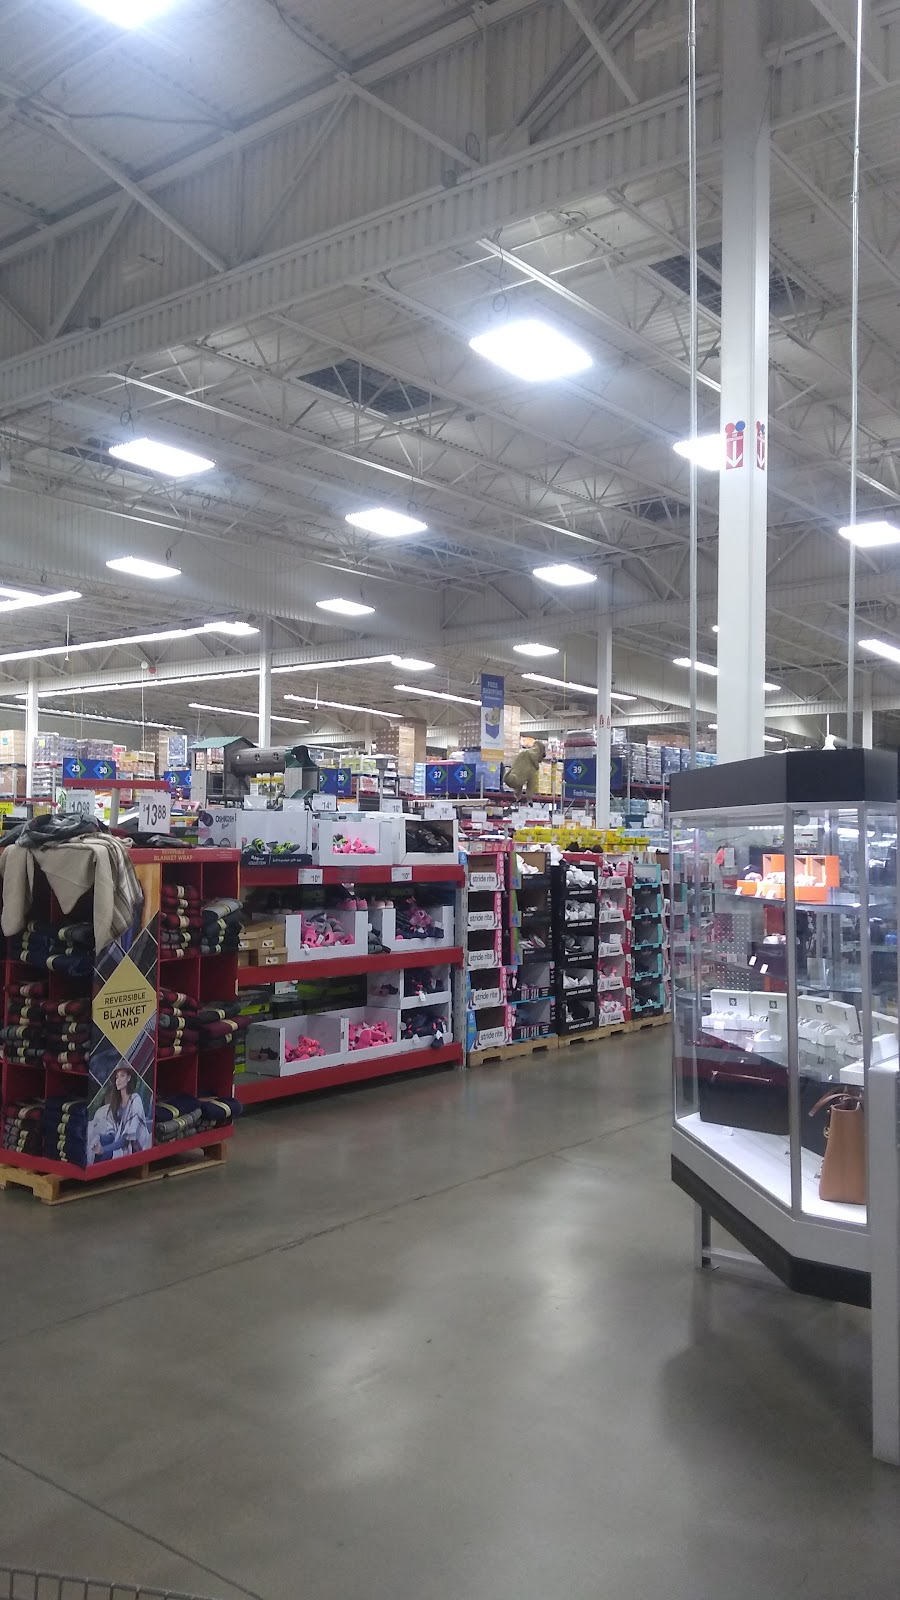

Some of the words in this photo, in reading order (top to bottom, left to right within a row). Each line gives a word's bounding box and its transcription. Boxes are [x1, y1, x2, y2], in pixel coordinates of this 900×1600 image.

[71, 764, 80, 773] 29
[99, 766, 108, 774] 30
[573, 765, 582, 774] 39
[337, 774, 345, 782] 36
[433, 771, 442, 779] 37
[459, 770, 468, 778] 38
[169, 776, 176, 784] 33
[472, 875, 486, 883] stride
[487, 874, 495, 882] rite
[469, 914, 484, 922] stride
[469, 953, 484, 962] stride
[104, 992, 146, 1005] REVERSIBLE
[474, 992, 489, 1001] stride
[489, 991, 498, 999] rite
[103, 1004, 147, 1020] BLANKET
[110, 1017, 140, 1031] WRAP
[480, 1032, 494, 1041] stride
[494, 1030, 504, 1038] rite
